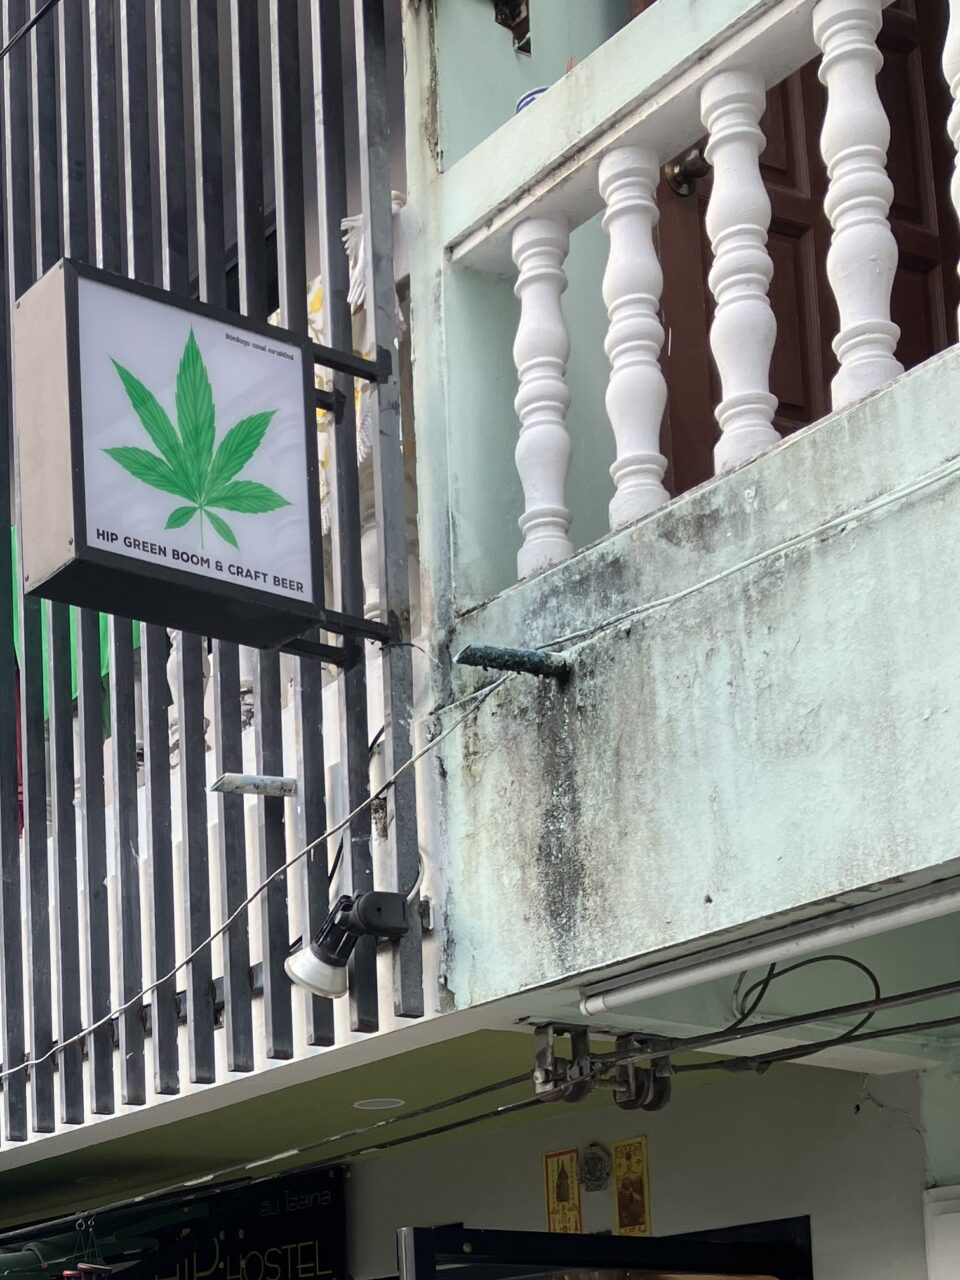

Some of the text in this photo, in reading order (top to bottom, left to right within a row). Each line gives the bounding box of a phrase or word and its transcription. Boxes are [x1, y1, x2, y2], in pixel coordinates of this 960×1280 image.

[96, 529, 305, 593] HIP GREEN BOOM & CRAFT BEER
